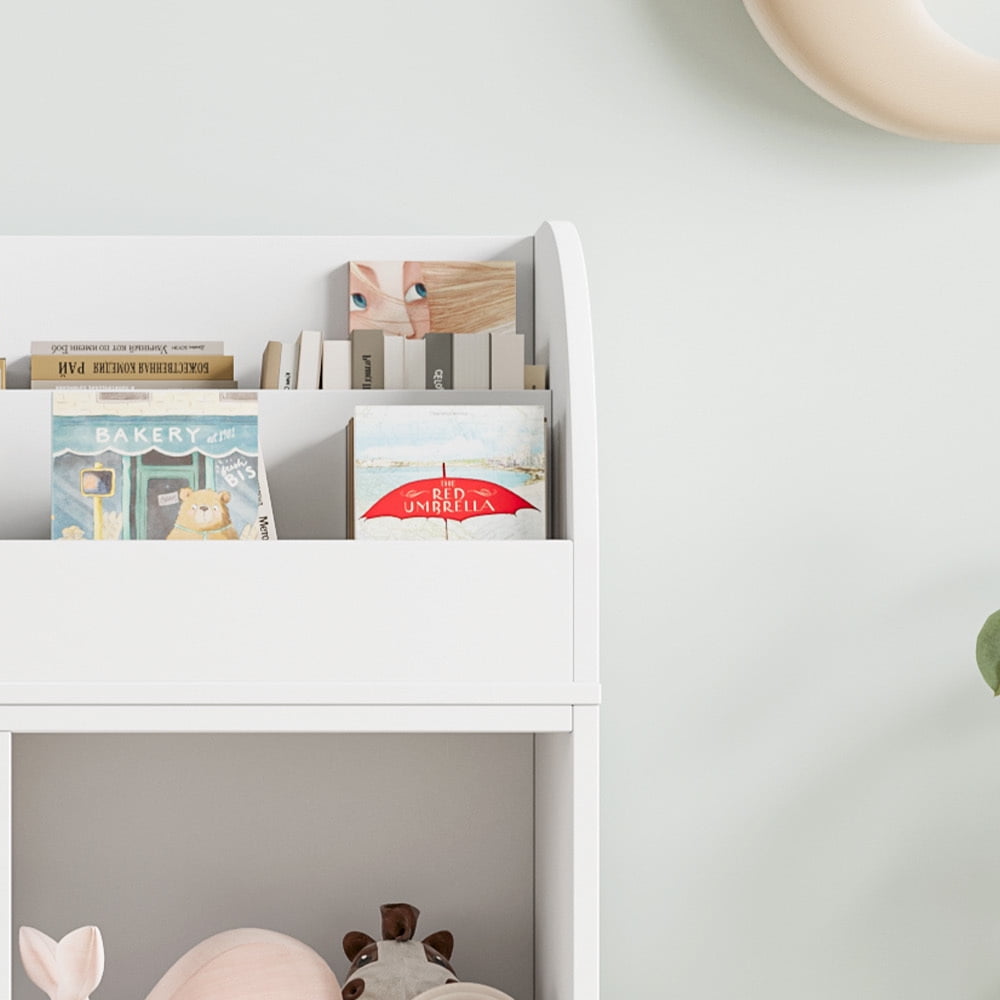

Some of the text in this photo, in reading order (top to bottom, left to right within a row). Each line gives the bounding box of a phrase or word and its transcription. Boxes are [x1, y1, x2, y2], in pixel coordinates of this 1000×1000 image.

[58, 361, 209, 378] БОЖЕСТВЕННАЯ КОМЕДИЯ РАЙ
[95, 426, 201, 443] BAKERY
[432, 487, 466, 500] RED
[403, 500, 496, 515] UMBRELLA
